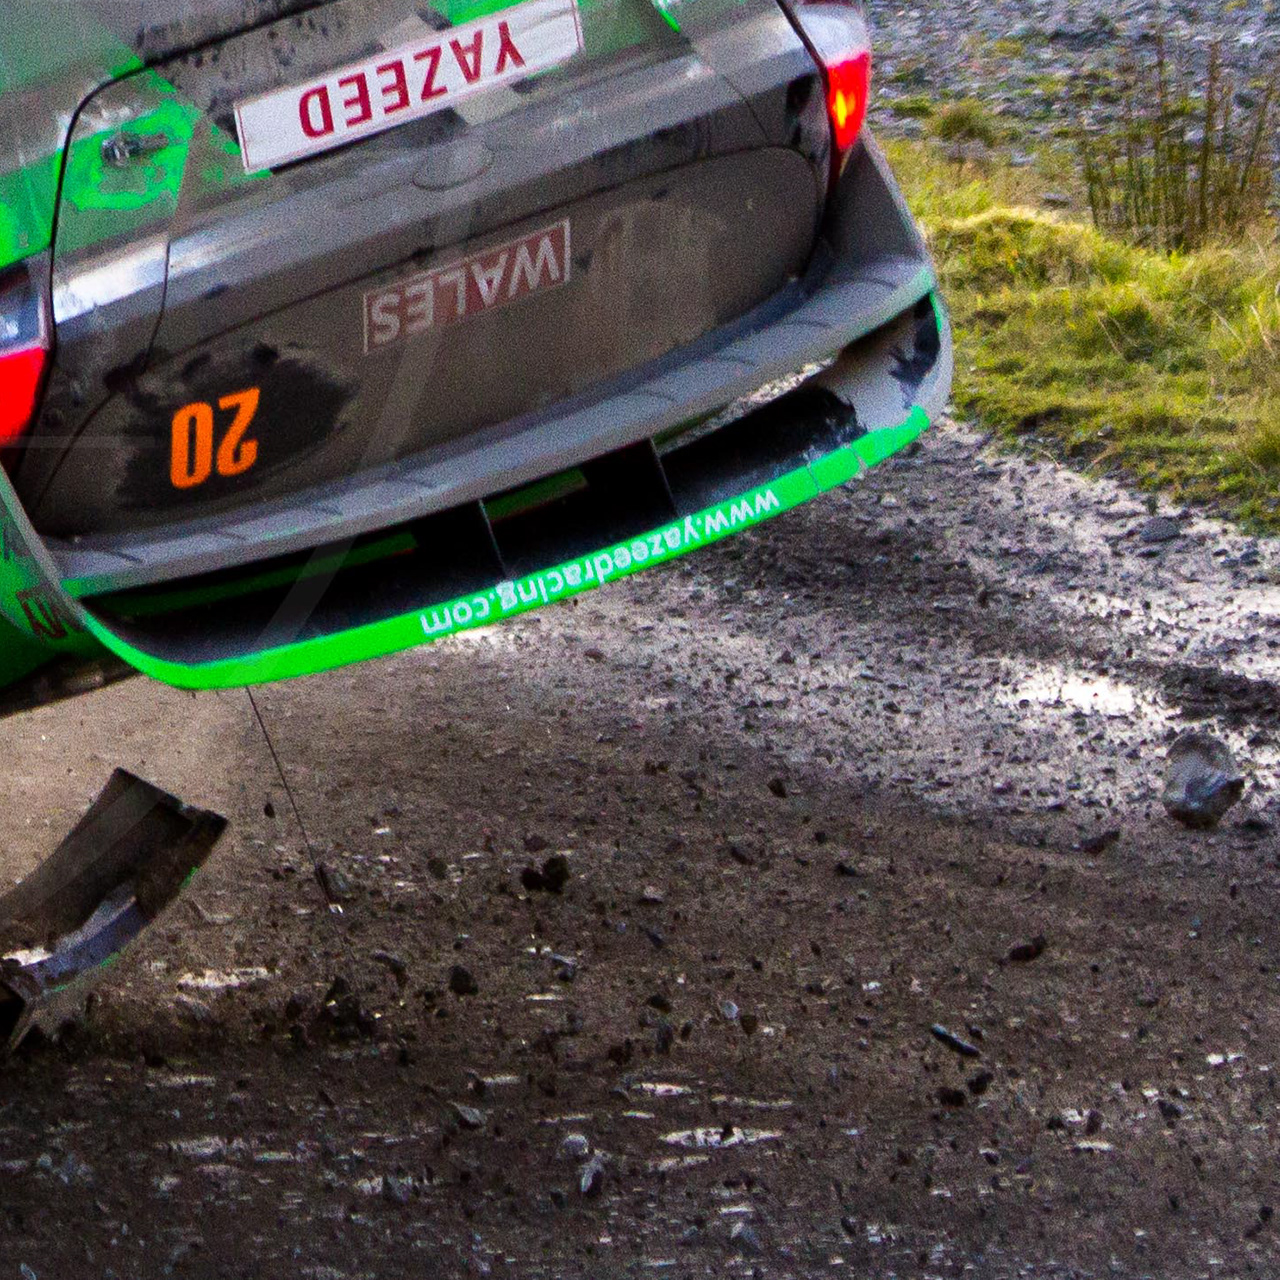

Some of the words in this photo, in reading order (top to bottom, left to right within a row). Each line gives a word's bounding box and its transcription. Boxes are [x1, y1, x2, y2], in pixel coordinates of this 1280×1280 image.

[299, 21, 526, 138] YAZEED
[371, 236, 560, 343] WALES
[171, 387, 261, 490] 20
[420, 489, 779, 634] www.yazeedracing.com
